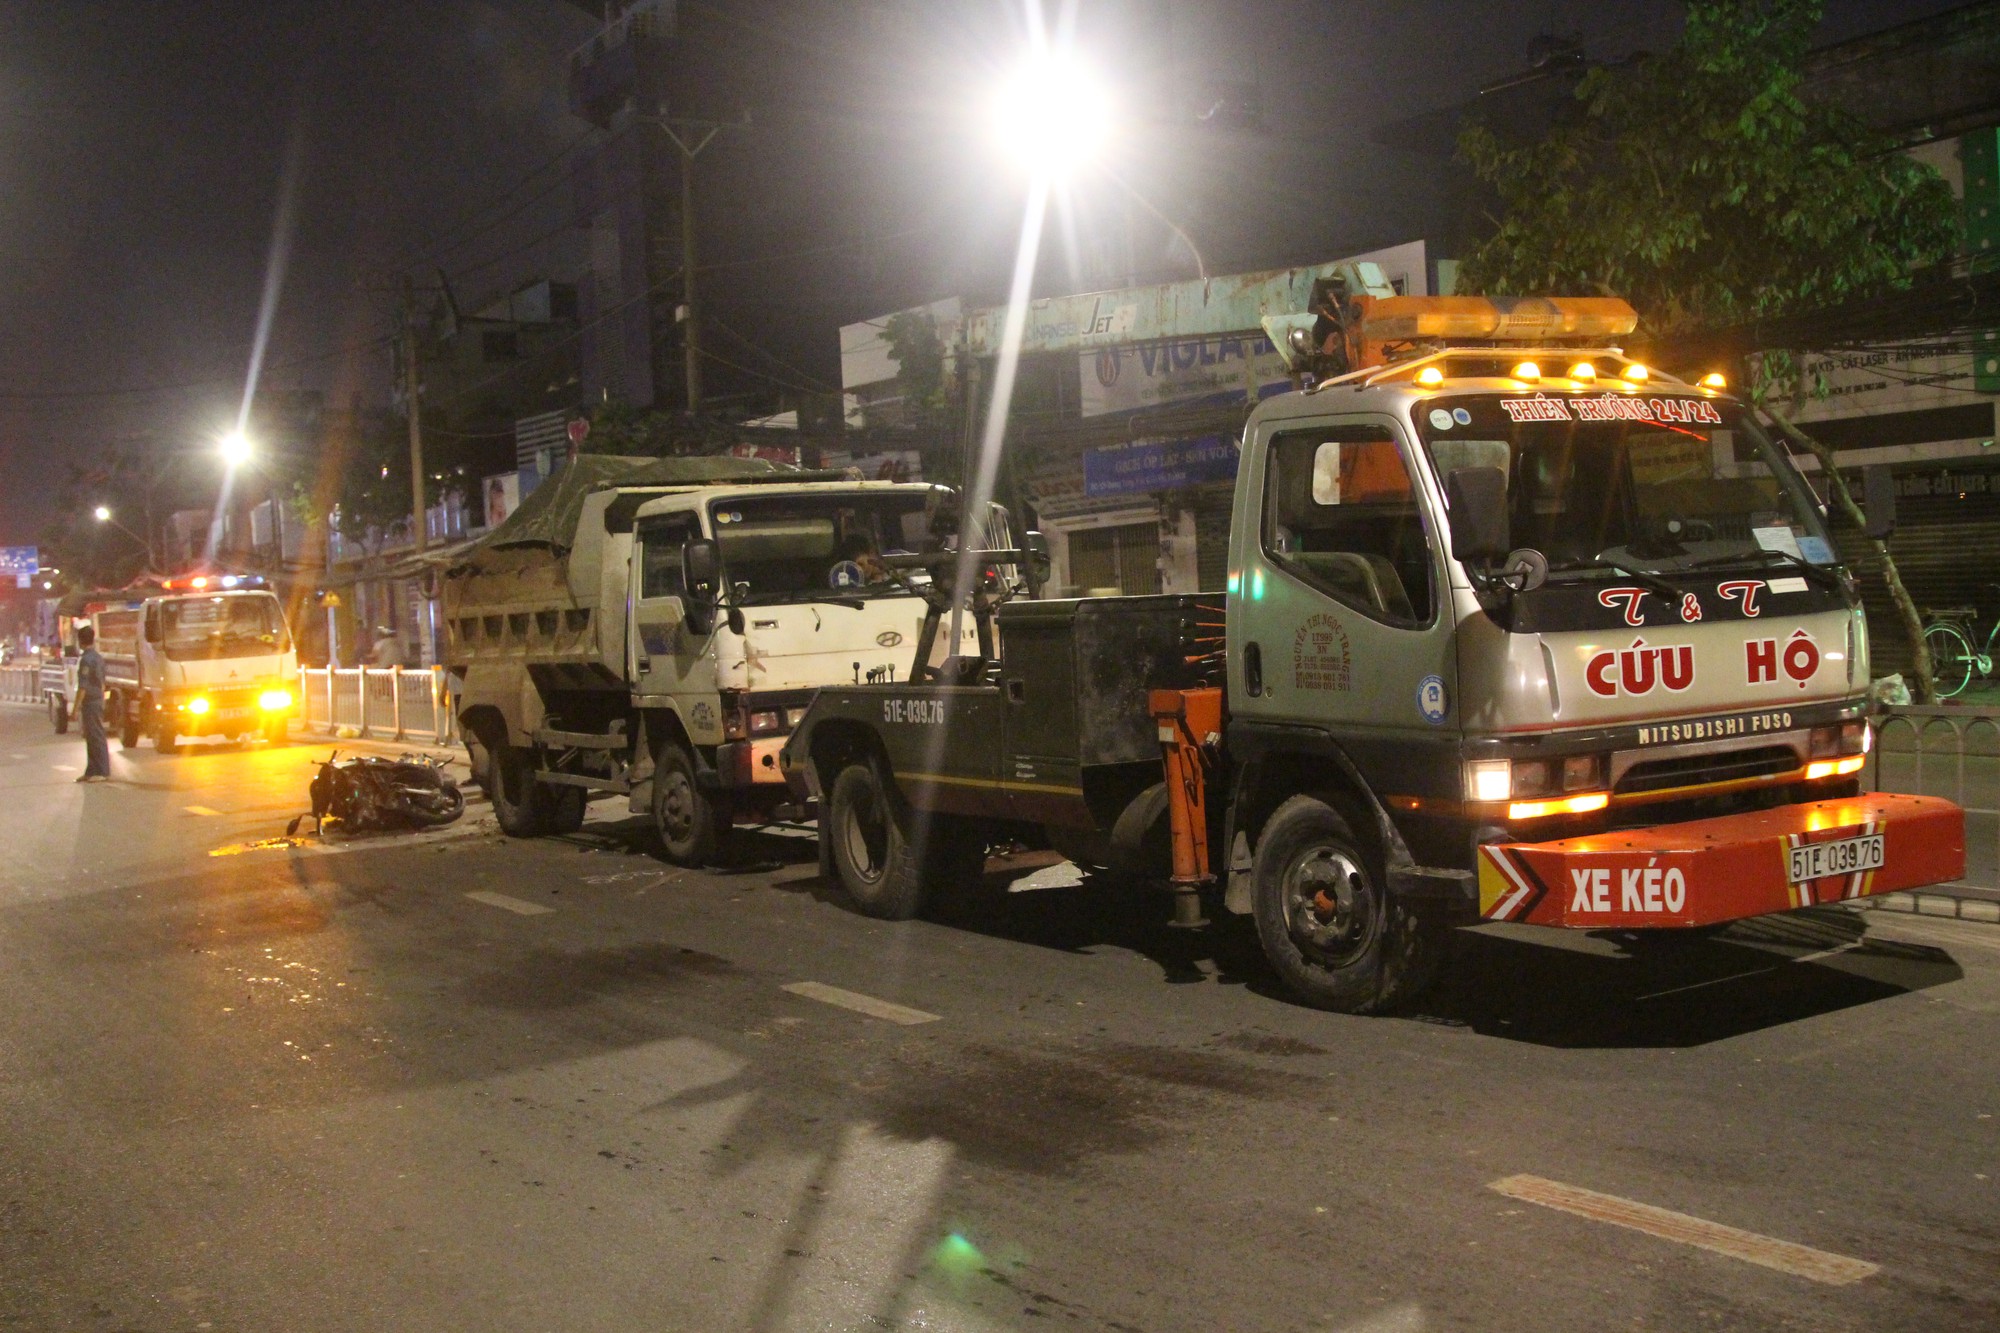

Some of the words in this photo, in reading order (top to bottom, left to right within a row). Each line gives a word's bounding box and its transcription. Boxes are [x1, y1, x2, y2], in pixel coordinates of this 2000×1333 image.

[1082, 297, 1114, 334] JET
[1500, 392, 1572, 422] THIÊN
[1649, 399, 1721, 424] 24/24
[1680, 593, 1702, 623] &
[1586, 638, 1695, 698] CỨU
[1745, 628, 1820, 689] HỘ
[883, 699, 944, 724] 51E-039.76
[1638, 717, 1743, 744] MITSUBISHI
[1748, 711, 1790, 731] FUSO
[1571, 867, 1612, 914] XE
[1620, 857, 1686, 914] KÉO
